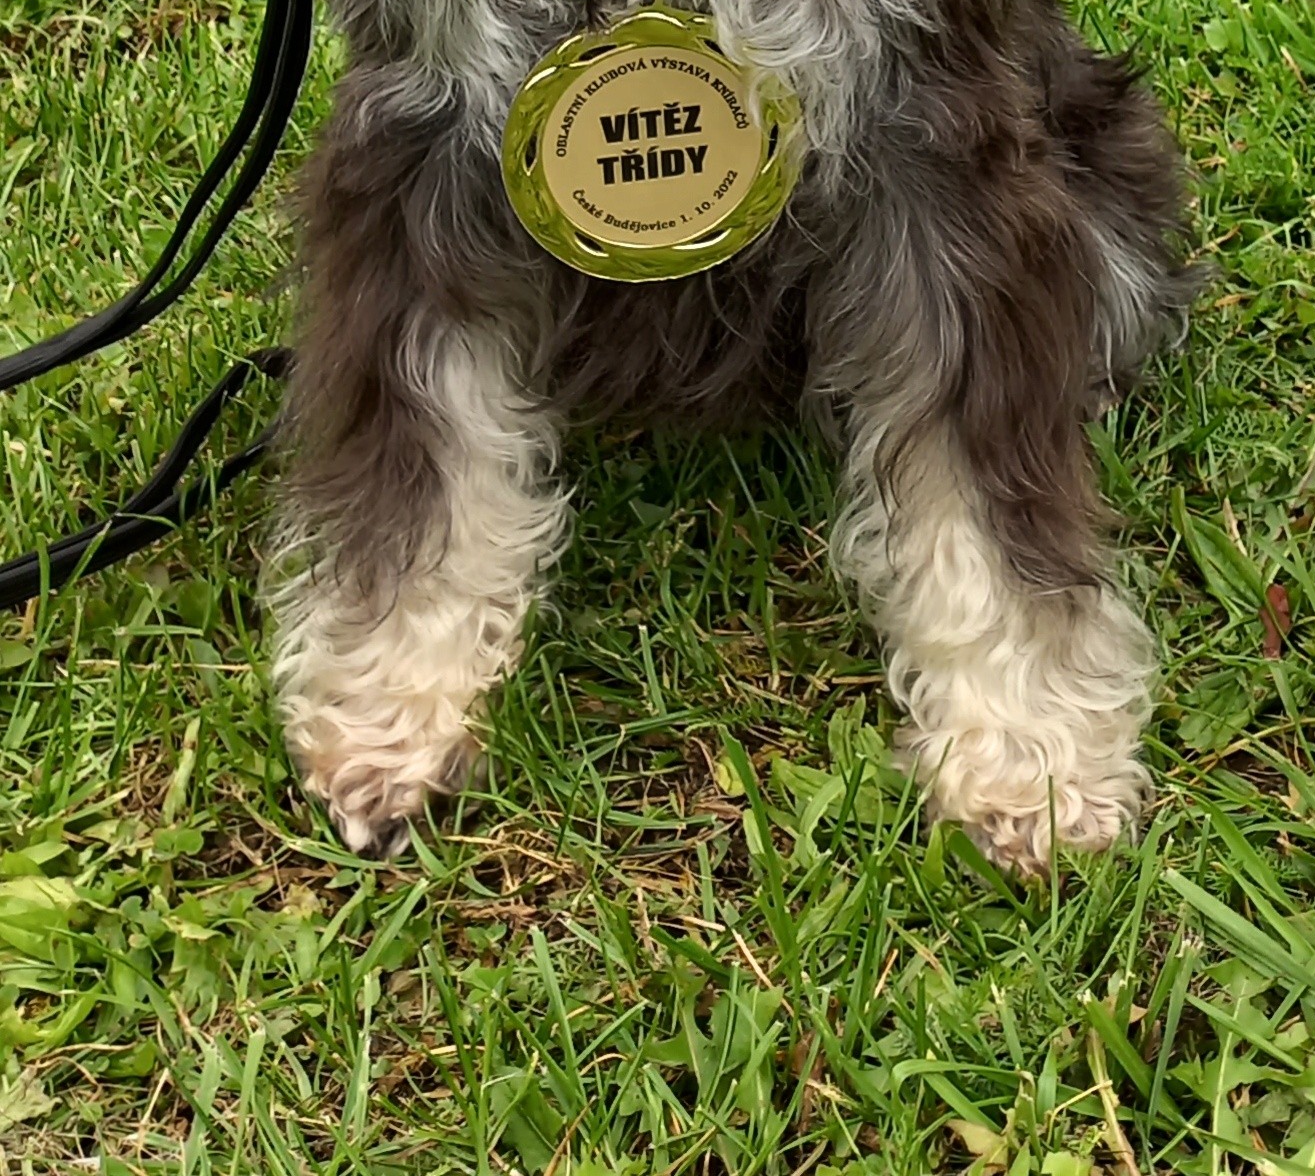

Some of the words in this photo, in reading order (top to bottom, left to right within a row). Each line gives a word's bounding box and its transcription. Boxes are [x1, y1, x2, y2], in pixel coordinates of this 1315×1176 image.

[556, 95, 588, 157] OBLASTNÍ
[584, 58, 647, 97] KLUBOVÁ
[651, 57, 711, 82] VÝSTAVA
[710, 78, 750, 130] KNÍRAČŮ
[600, 102, 702, 144] VÍTĚZ
[597, 144, 708, 185] TŘÍDY
[572, 189, 604, 220] České
[604, 214, 676, 233] Budějovice
[680, 214, 694, 224] 1.
[695, 200, 716, 216] 10.
[713, 169, 739, 200] 2022
